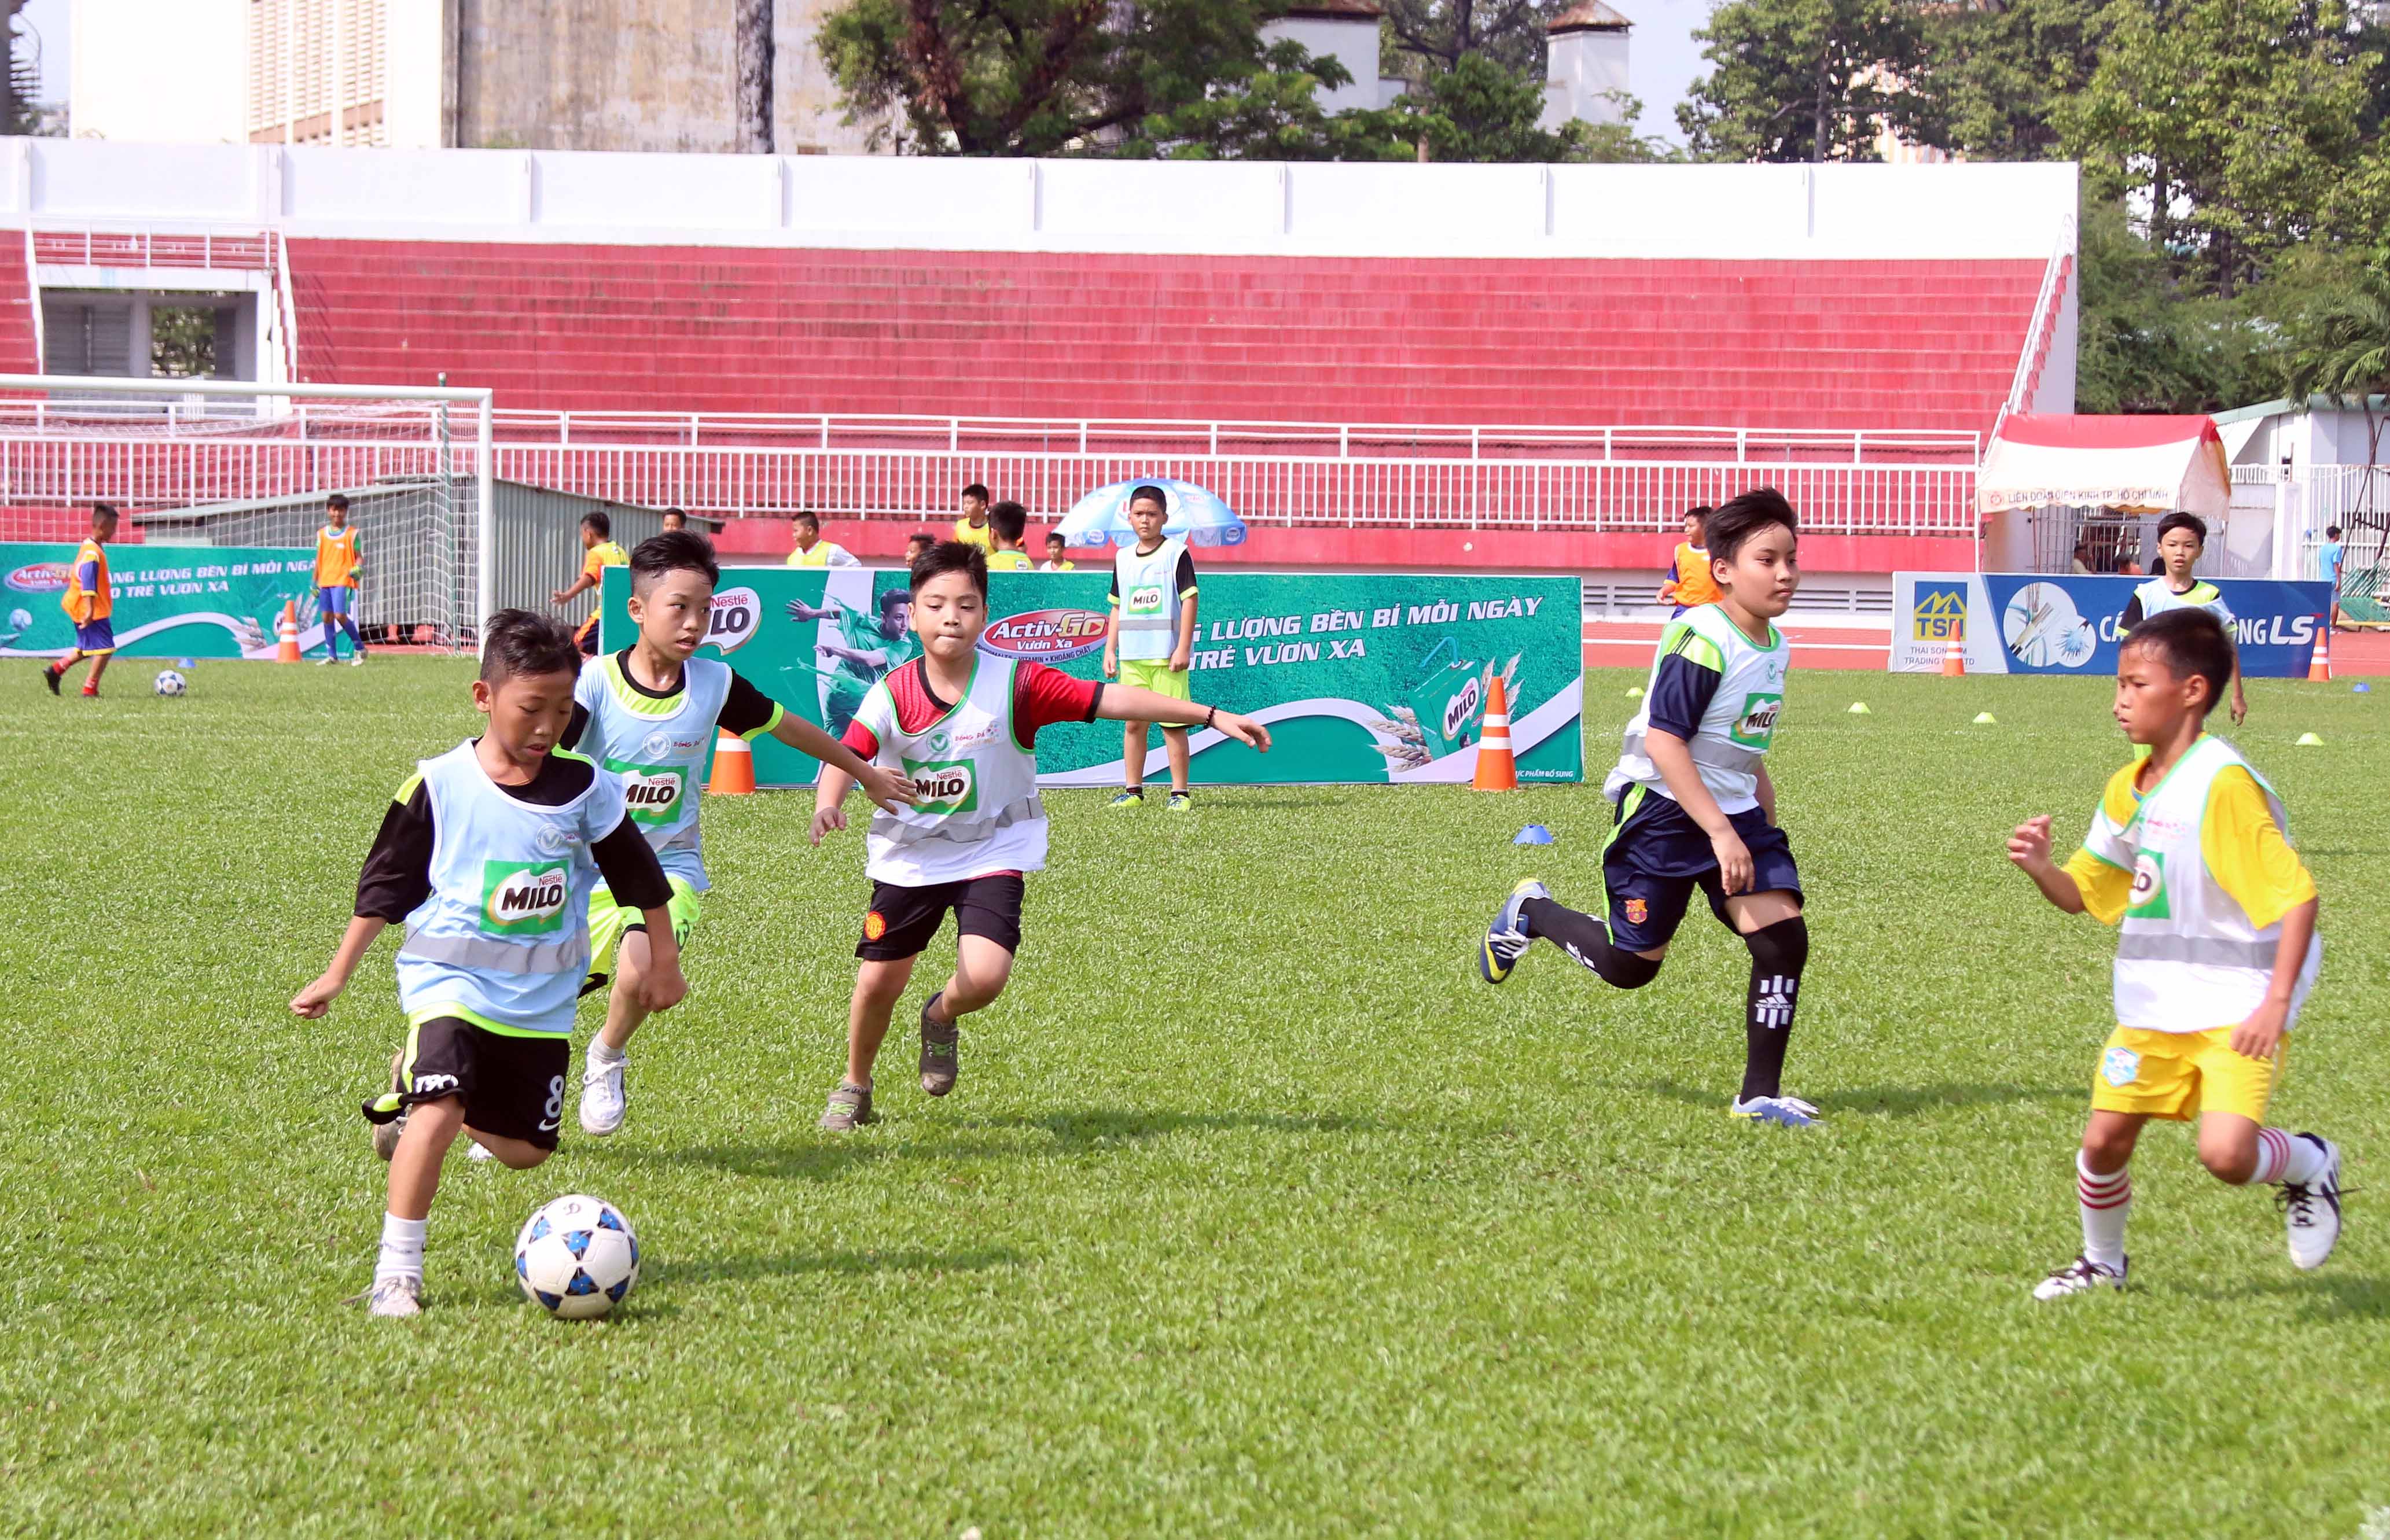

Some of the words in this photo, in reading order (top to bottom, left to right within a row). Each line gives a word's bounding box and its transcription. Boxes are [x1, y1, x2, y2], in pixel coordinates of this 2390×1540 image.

[207, 580, 229, 593] XA
[1133, 594, 1158, 606] MILO
[1210, 615, 1302, 641] LƯỢNG
[1310, 608, 1365, 633] BỀN
[1371, 603, 1401, 628] BỈ
[1407, 598, 1459, 625] MỖI
[1467, 596, 1545, 621] NGÀY
[2269, 615, 2316, 646] LS
[1055, 639, 1073, 649] Xa
[1245, 642, 1321, 666] VƯƠN
[1327, 638, 1366, 660] XA
[1904, 657, 1940, 665] TRADING
[1447, 689, 1476, 731] MILO
[915, 779, 965, 797] MILO
[501, 884, 562, 911] MILO
[546, 1074, 565, 1119] 8
